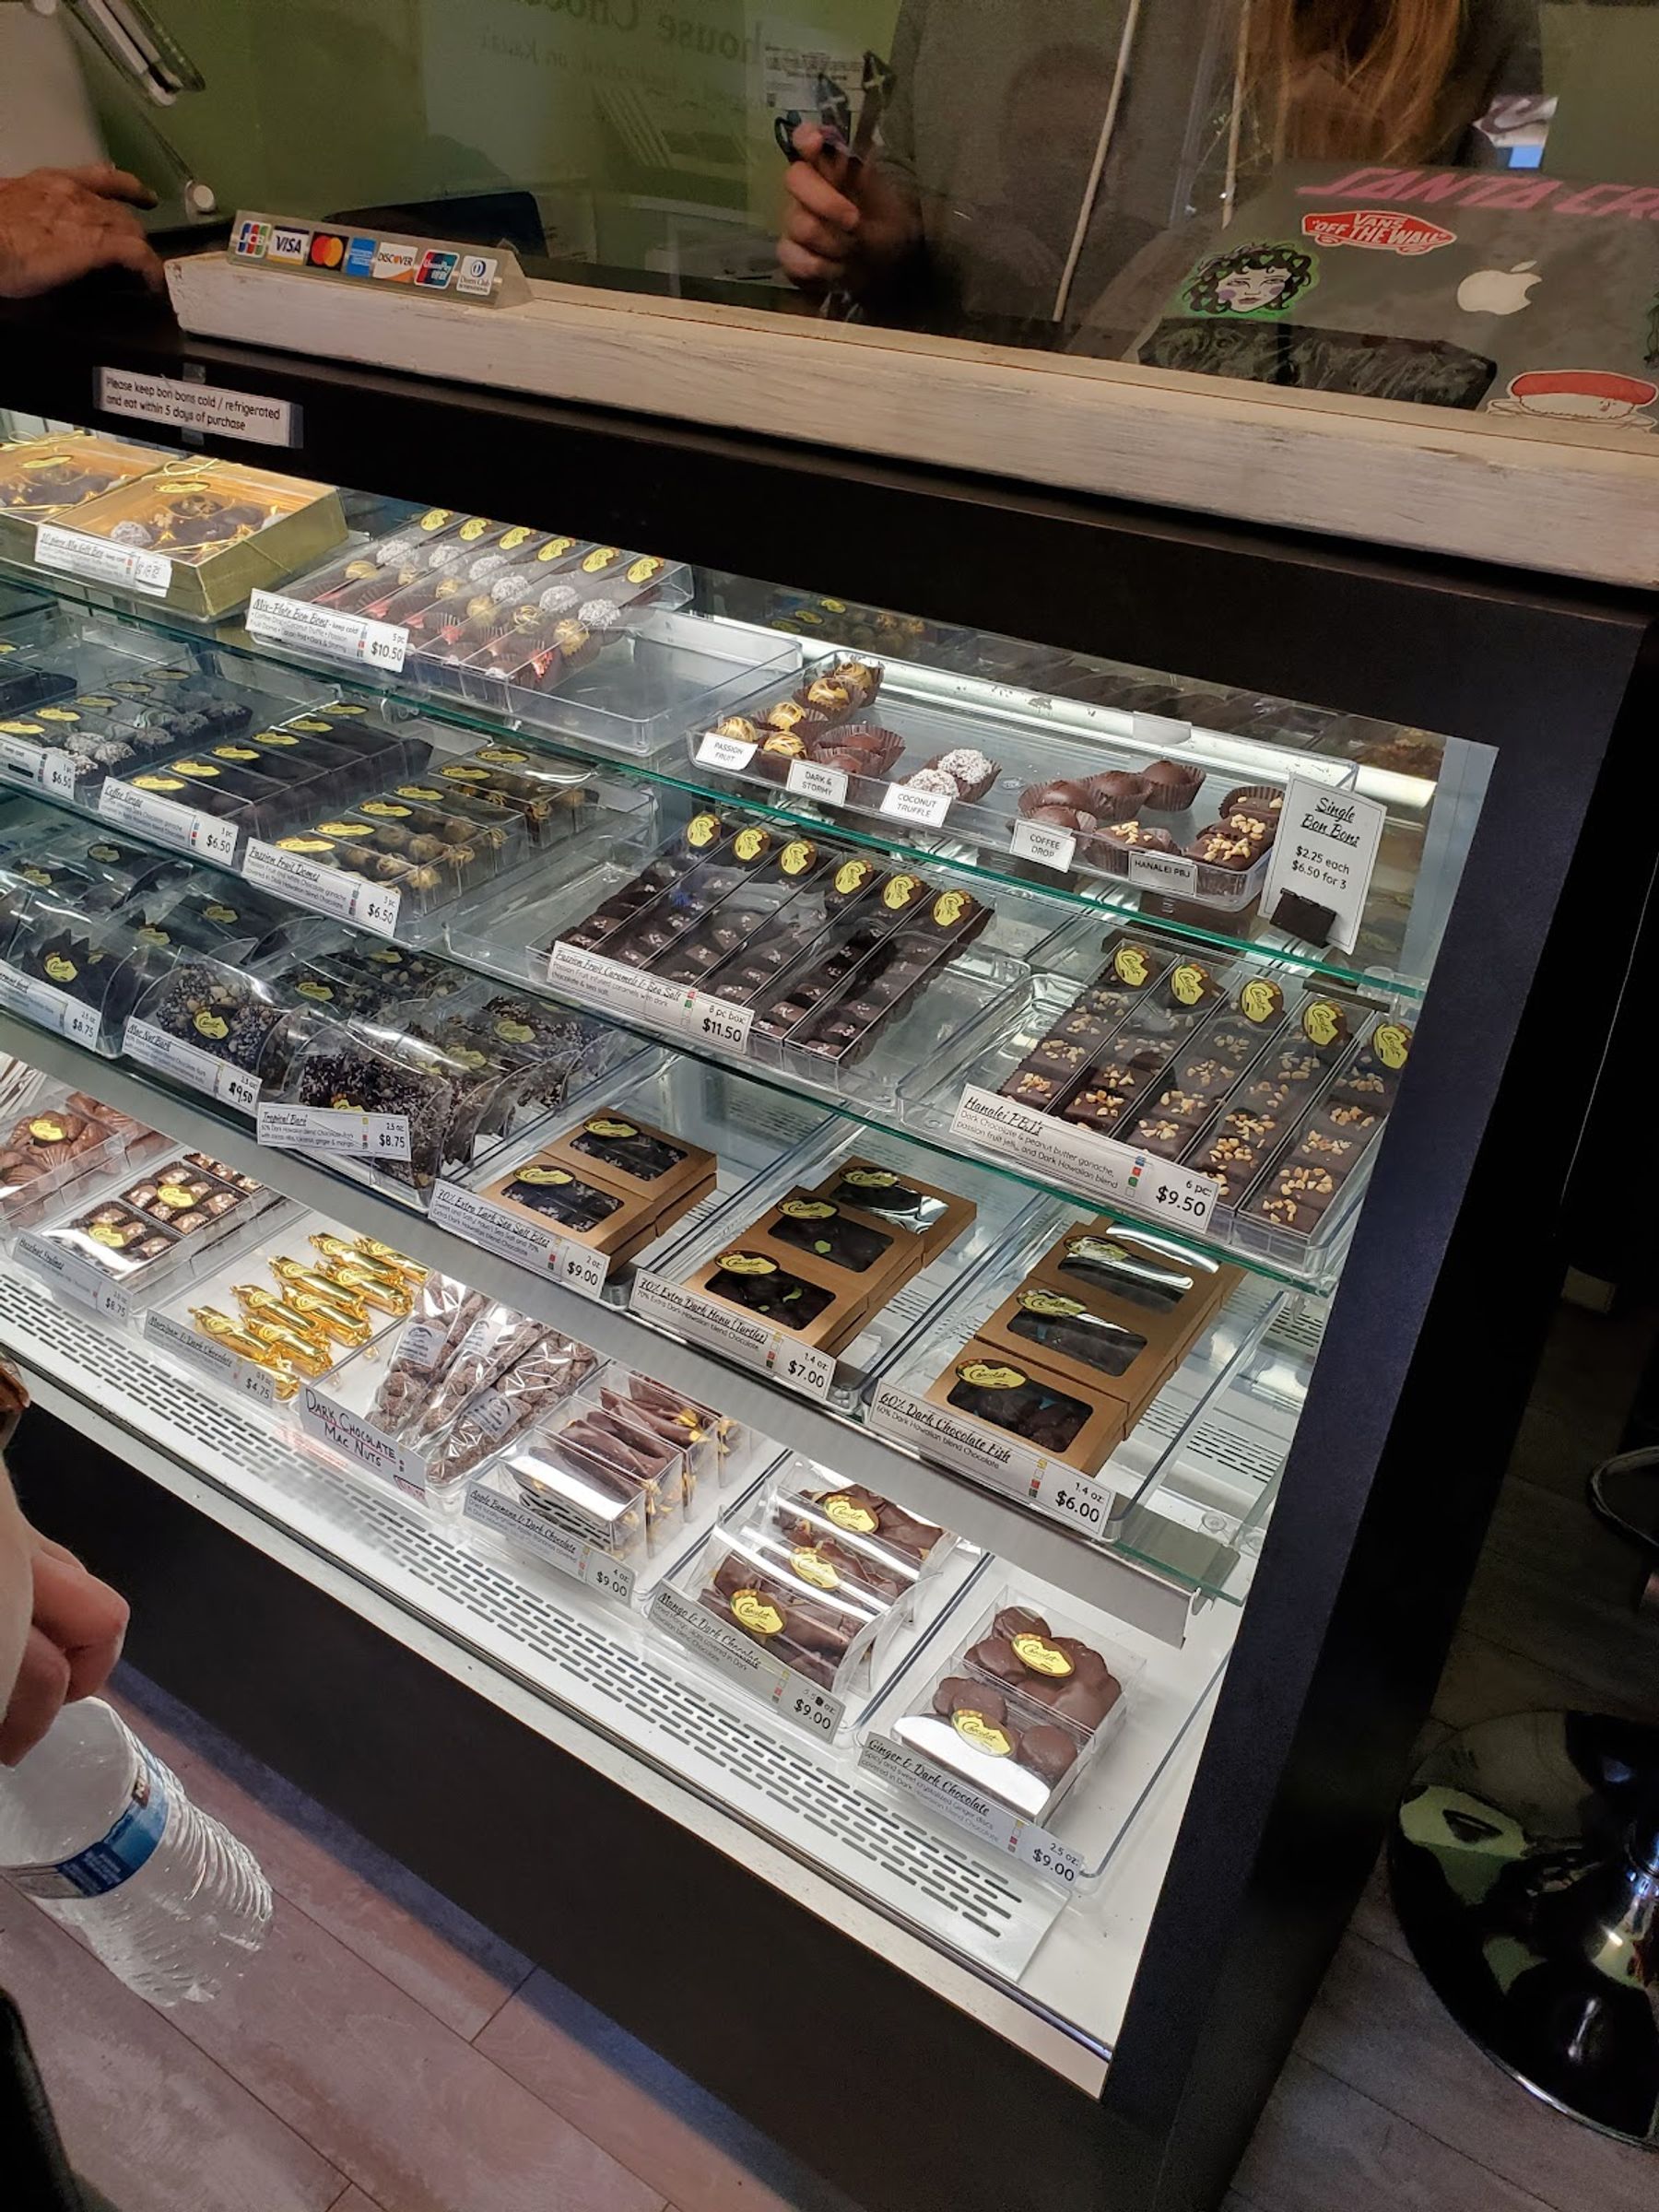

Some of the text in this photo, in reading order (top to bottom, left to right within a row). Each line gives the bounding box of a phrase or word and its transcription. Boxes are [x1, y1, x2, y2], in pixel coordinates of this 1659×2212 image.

[1298, 167, 1563, 209] SANTA
[1354, 213, 1407, 229] VANS
[276, 235, 302, 254] VISA
[1350, 226, 1384, 242] THE
[107, 377, 131, 391] Please
[135, 382, 153, 396] keep
[157, 386, 172, 398] bon
[175, 390, 194, 403] bons
[197, 394, 215, 406] cold
[226, 398, 279, 421] refrigerated
[105, 393, 244, 432] and eat within 5 days of purchase
[371, 641, 402, 661] $10.50
[714, 741, 745, 757] PASSION
[714, 751, 736, 763] FRUIT
[805, 771, 824, 783] DARK
[801, 782, 834, 797] STORMY
[896, 804, 932, 818] TRUFFLE
[897, 793, 937, 809] COCONUT
[1315, 796, 1358, 824] Single
[1300, 813, 1333, 835] Bon
[206, 834, 230, 853] $6.50
[1030, 834, 1060, 850] COFFEE
[1032, 846, 1054, 858] DROP
[1135, 860, 1171, 874] HANALEI
[1295, 844, 1350, 876] $2.25 each
[1290, 859, 1347, 890] $6.50 for 3
[368, 902, 393, 924] $6.50
[714, 1008, 726, 1020] pc
[73, 1018, 93, 1037] $8.75
[702, 1018, 741, 1042] $11.50
[965, 1095, 1009, 1122] Hanalei
[380, 1134, 404, 1147] $8.75
[960, 1110, 978, 1123] Dark
[980, 1117, 1017, 1137] Chocolate
[1025, 1136, 1052, 1153] peanut
[1053, 1147, 1077, 1162] butter
[1021, 1145, 1037, 1158] and
[1038, 1152, 1056, 1165] Dark
[1058, 1159, 1092, 1179] Hawaiian
[1094, 1174, 1117, 1190] blend
[1185, 1180, 1193, 1190] 6
[455, 1196, 476, 1214] Extra
[1156, 1185, 1206, 1218] $9.50
[586, 1254, 592, 1264] 2
[567, 1261, 598, 1285] $9.00
[639, 1277, 659, 1295] 70%
[661, 1287, 683, 1306] Extra
[684, 1298, 706, 1316] Dark
[803, 1352, 816, 1364] 1.4
[787, 1359, 825, 1388] $7.00
[247, 1377, 269, 1399] $4.75
[305, 1389, 394, 1459] DARK CHOCOLATE
[878, 1390, 1012, 1463] 60% Dark Chocolate Fish
[324, 1422, 381, 1466] MAC NUTS
[890, 1412, 908, 1425] Dark
[942, 1436, 961, 1452] blend
[963, 1446, 1000, 1470] Chocolate
[1073, 1481, 1089, 1495] 1.4
[1054, 1489, 1101, 1524] $6.00
[596, 1571, 627, 1596] $9.00
[657, 1591, 688, 1617] Mango
[698, 1616, 720, 1640] Dark
[720, 1632, 761, 1668] Chocolate
[794, 1698, 830, 1731] $9.00
[867, 1738, 901, 1765] Ginger
[914, 1762, 941, 1786] Dark
[941, 1780, 991, 1816] Chocolate
[1048, 1843, 1065, 1857] 2.5
[1031, 1849, 1075, 1882] $9.00
